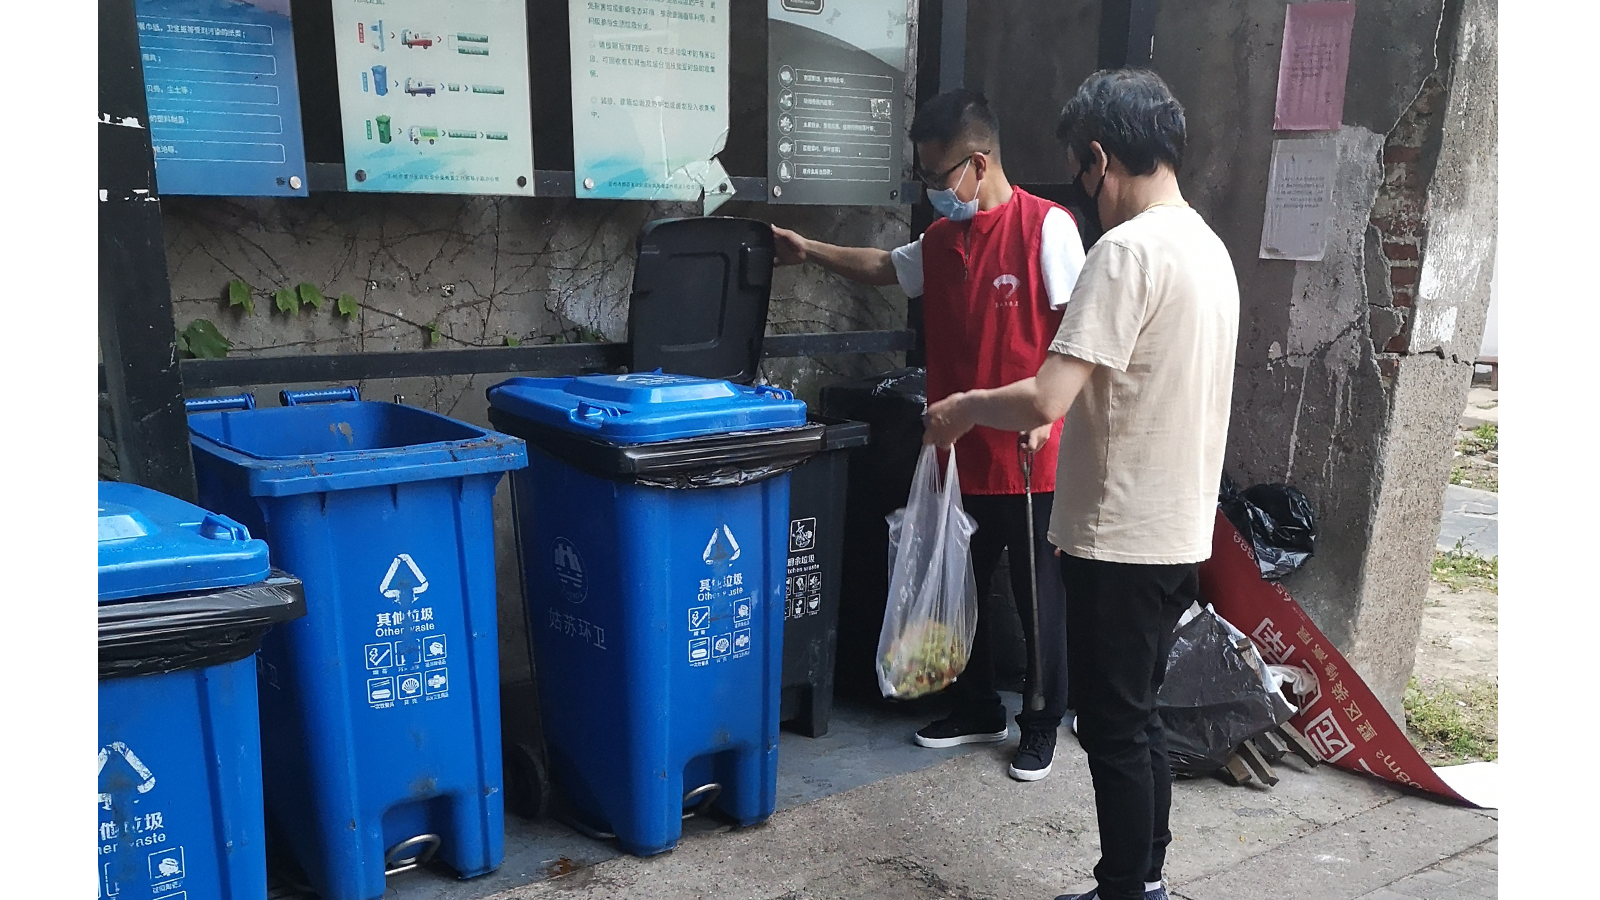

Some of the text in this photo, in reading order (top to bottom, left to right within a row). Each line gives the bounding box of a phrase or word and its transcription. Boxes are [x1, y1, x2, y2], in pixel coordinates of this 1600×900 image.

[375, 625, 405, 638] Other
[548, 606, 607, 651] 姑苏环卫
[1296, 624, 1378, 744] 墅区装修高层
